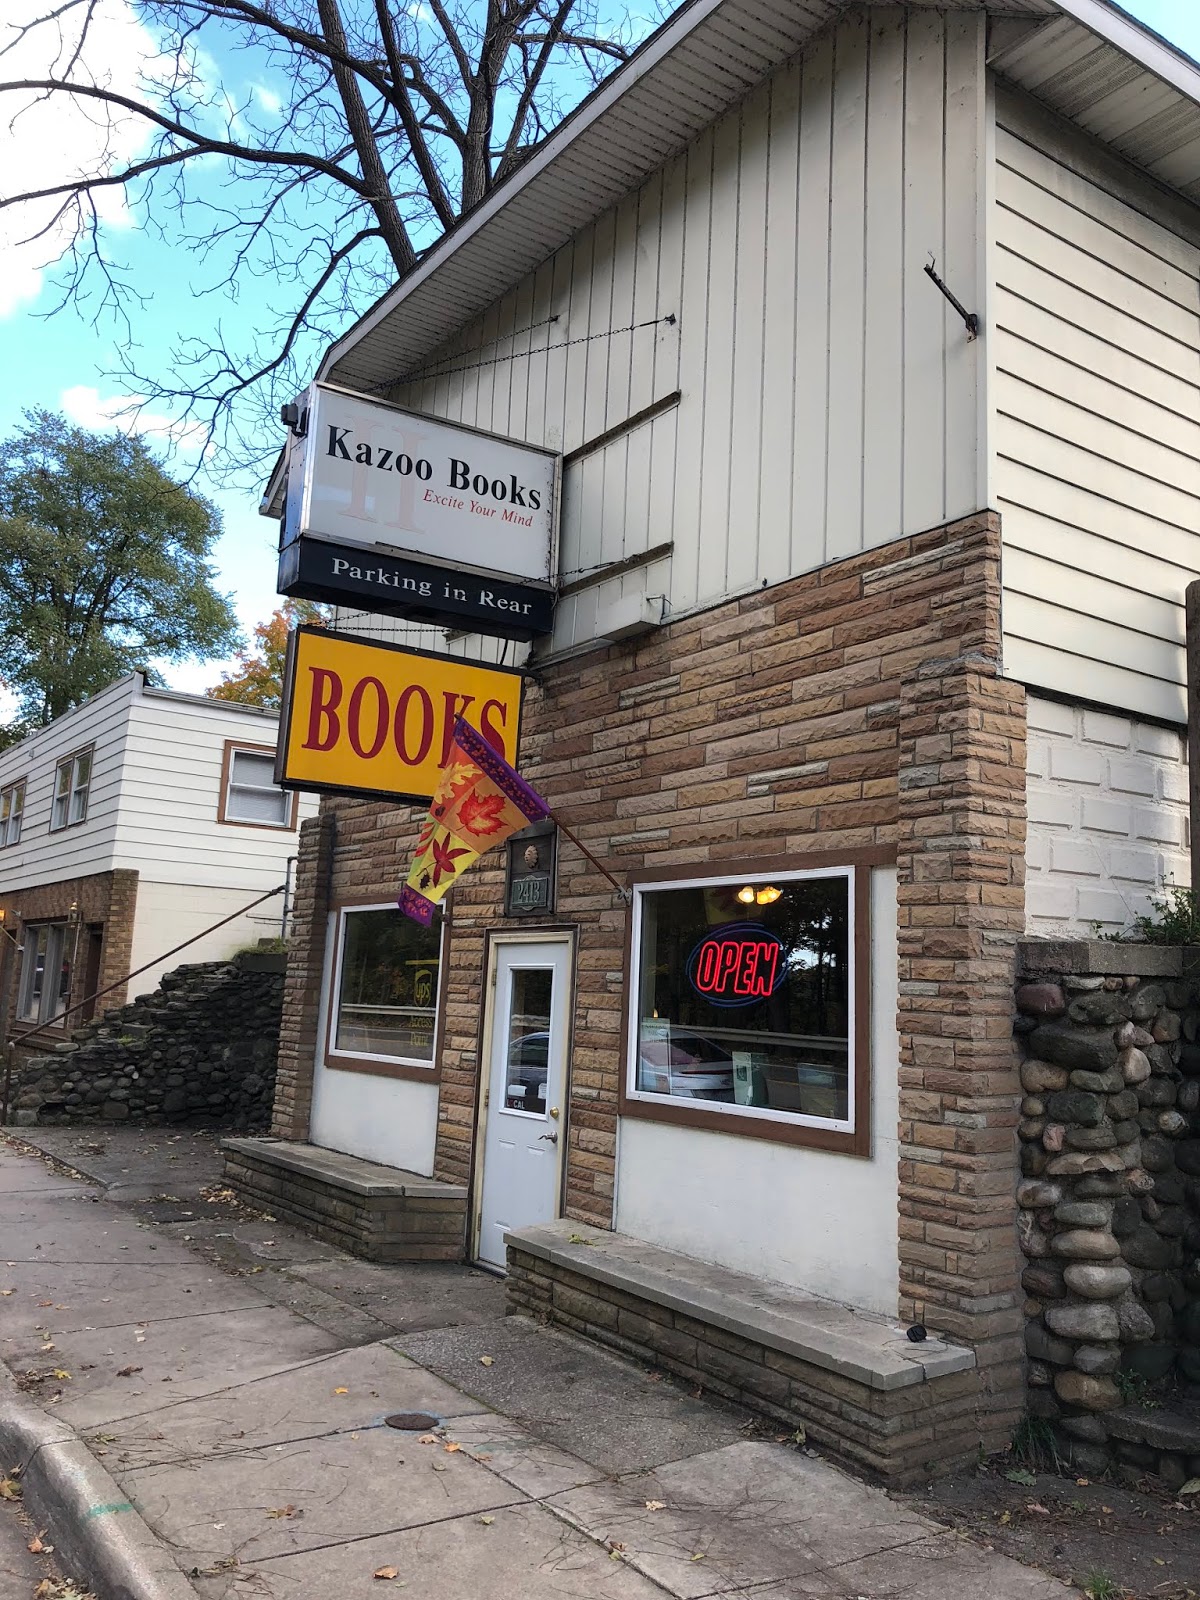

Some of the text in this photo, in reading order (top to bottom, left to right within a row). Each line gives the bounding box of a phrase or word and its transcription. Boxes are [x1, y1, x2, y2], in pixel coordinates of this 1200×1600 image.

[326, 424, 541, 510] Kazoo Books
[422, 488, 533, 527] Excite Your Mind
[331, 557, 532, 615] Parking in Rear
[517, 880, 540, 903] 2413
[697, 941, 779, 996] OPEN
[416, 982, 431, 1005] ups
